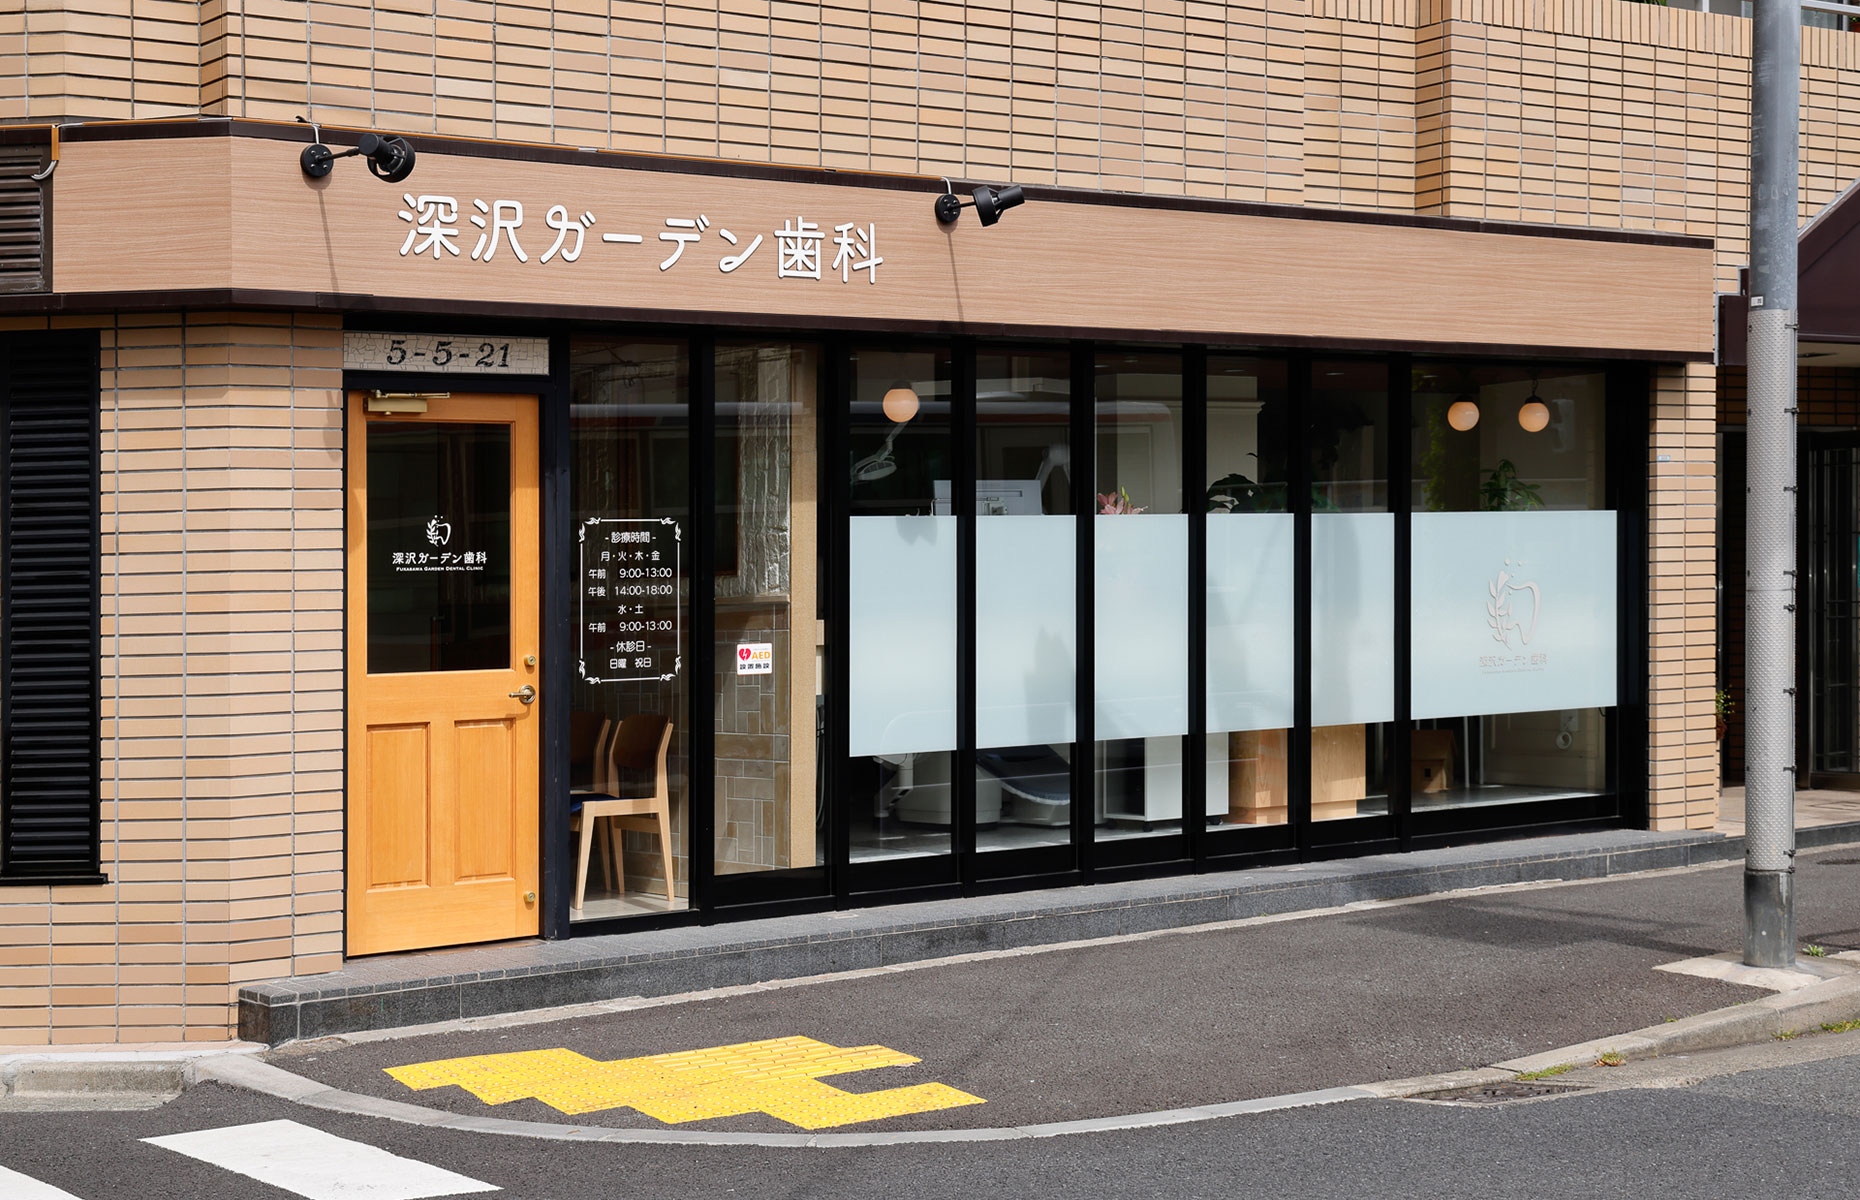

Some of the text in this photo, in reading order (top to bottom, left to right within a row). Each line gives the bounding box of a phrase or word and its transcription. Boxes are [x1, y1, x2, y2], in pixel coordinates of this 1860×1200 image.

[398, 193, 884, 285] 深沢ガーデン歯科
[386, 339, 511, 368] 5-5-21
[392, 551, 487, 564] 深沢ガーデン歯科
[588, 568, 673, 579] 午前 9:00-13:00
[588, 585, 673, 597] 午後 14:00-18:00
[617, 604, 644, 615] 水・土
[588, 620, 673, 633] 午前 9:00-13:00
[751, 651, 771, 660] AED
[609, 657, 652, 669] 日曜 祝日
